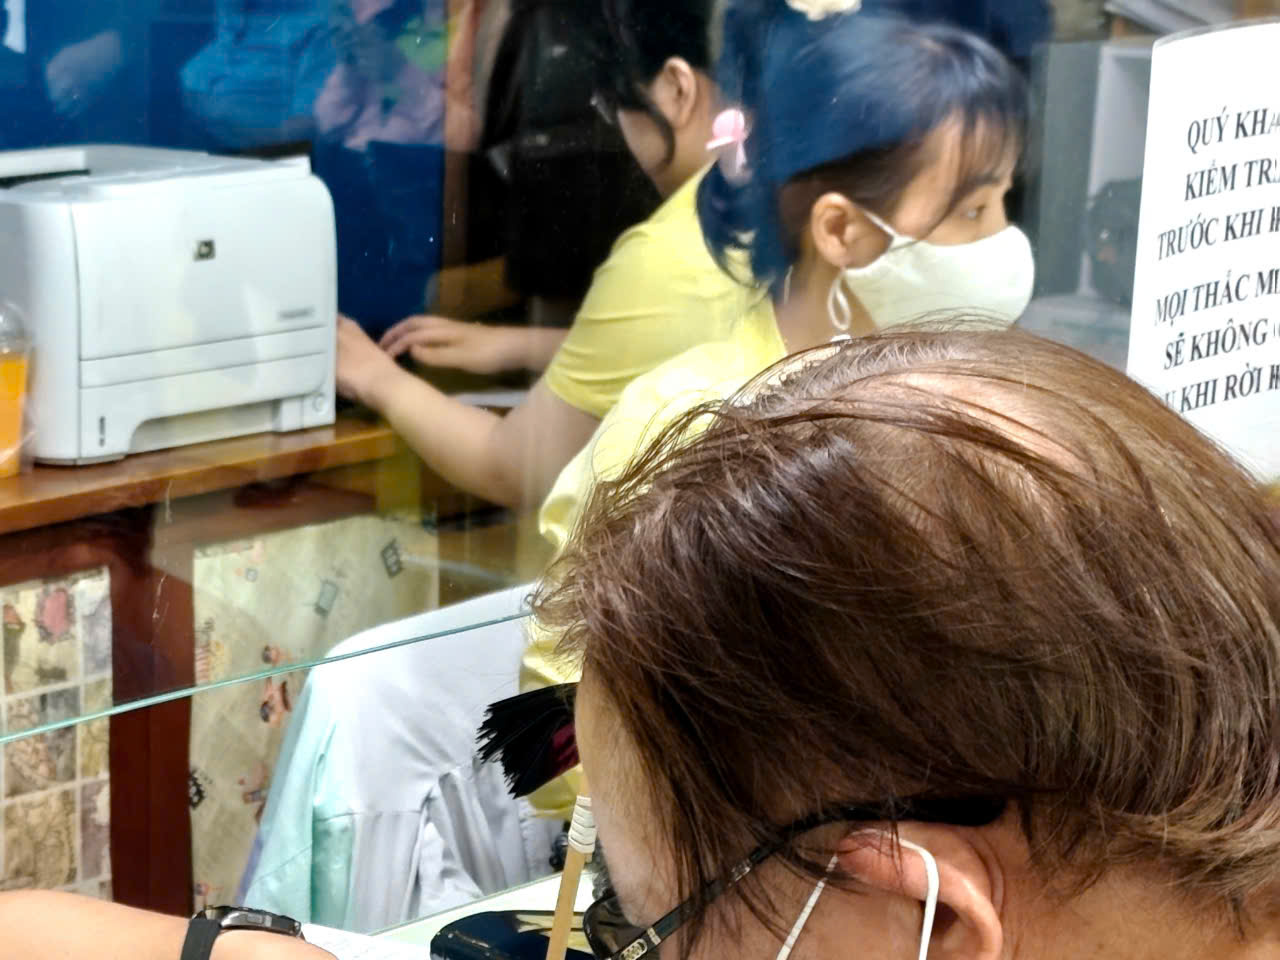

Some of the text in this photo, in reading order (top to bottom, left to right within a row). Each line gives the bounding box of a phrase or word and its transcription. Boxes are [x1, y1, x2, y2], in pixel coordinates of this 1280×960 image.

[1187, 105, 1229, 154] QUÝ
[1184, 159, 1238, 201] KIỂM
[1158, 212, 1219, 261] TRƯỚC
[1223, 208, 1265, 242] KHI
[1155, 288, 1188, 327] MỌI
[1189, 318, 1268, 362] KHÔNG
[1181, 378, 1219, 413] KHI
[1224, 362, 1263, 401] RỜI
